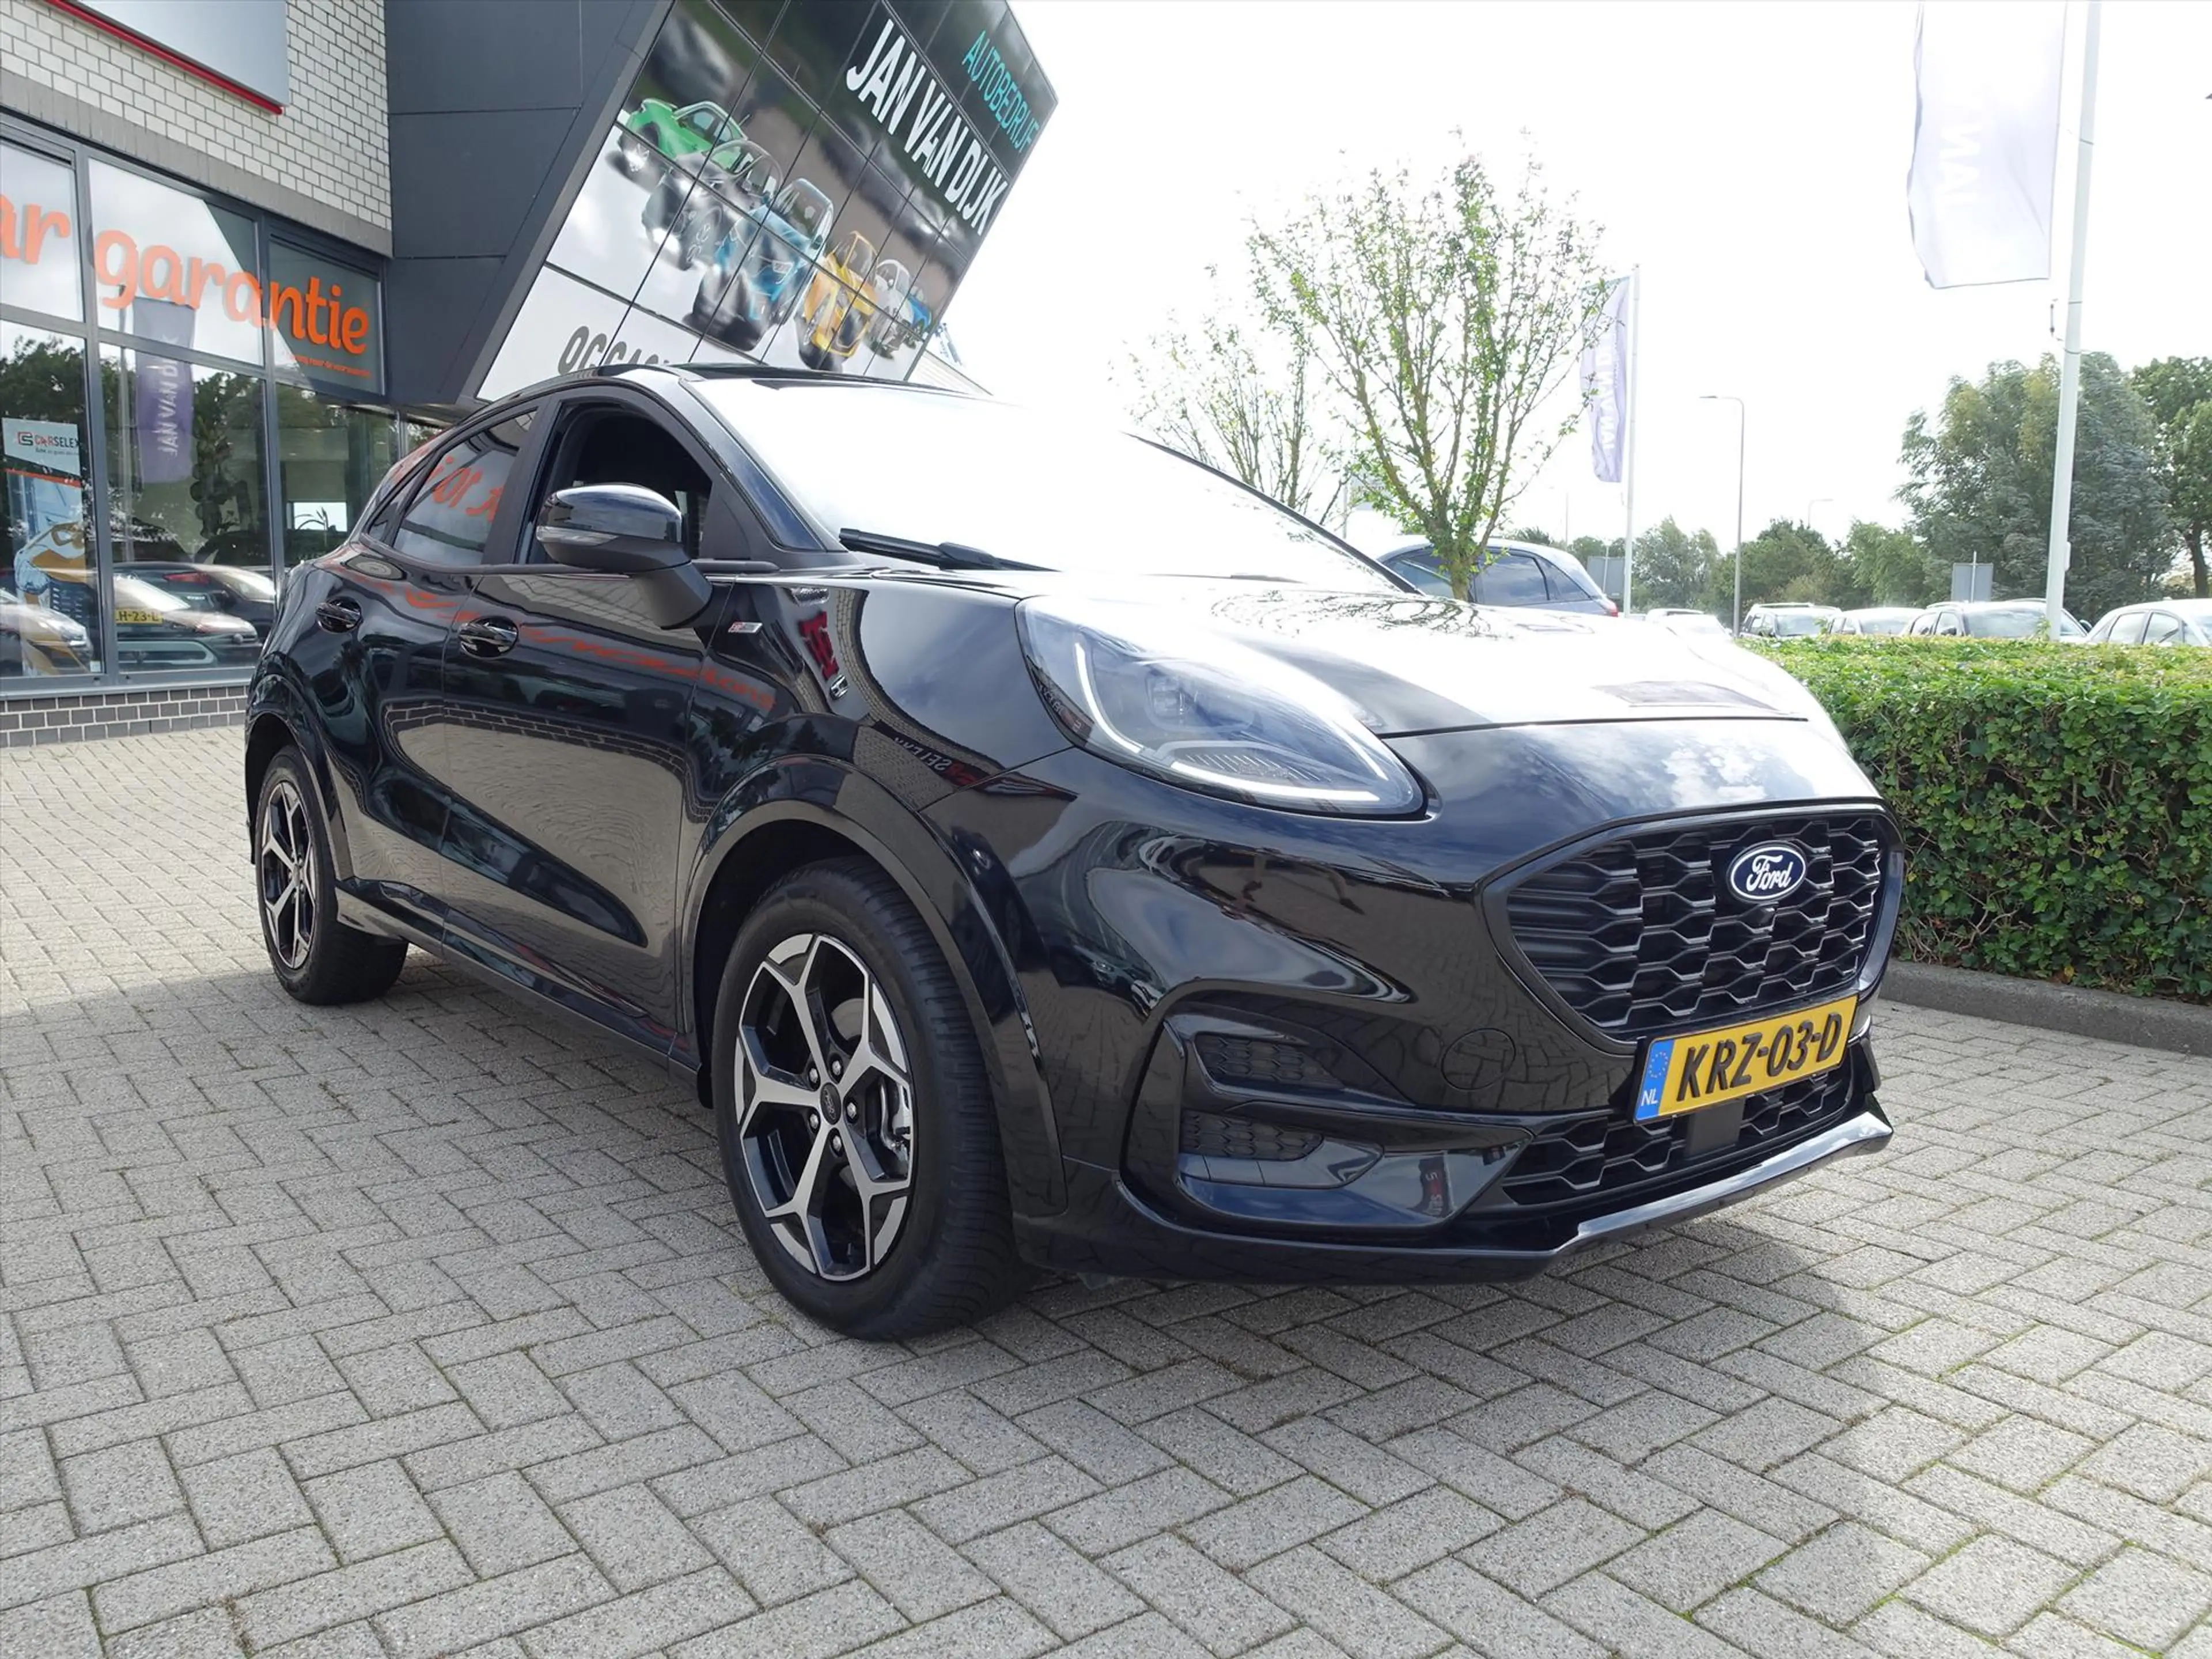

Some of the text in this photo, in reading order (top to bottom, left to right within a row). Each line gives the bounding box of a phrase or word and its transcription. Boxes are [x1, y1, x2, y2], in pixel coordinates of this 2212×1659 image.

[846, 18, 1007, 235] JAN VAN DIJK
[961, 30, 1039, 153] AUTOBEDRIJF
[94, 229, 369, 354] garantie
[1747, 855, 1793, 891] Ford
[1641, 1088, 1659, 1106] NL
[1676, 1012, 1842, 1101] KRZ-03-D
